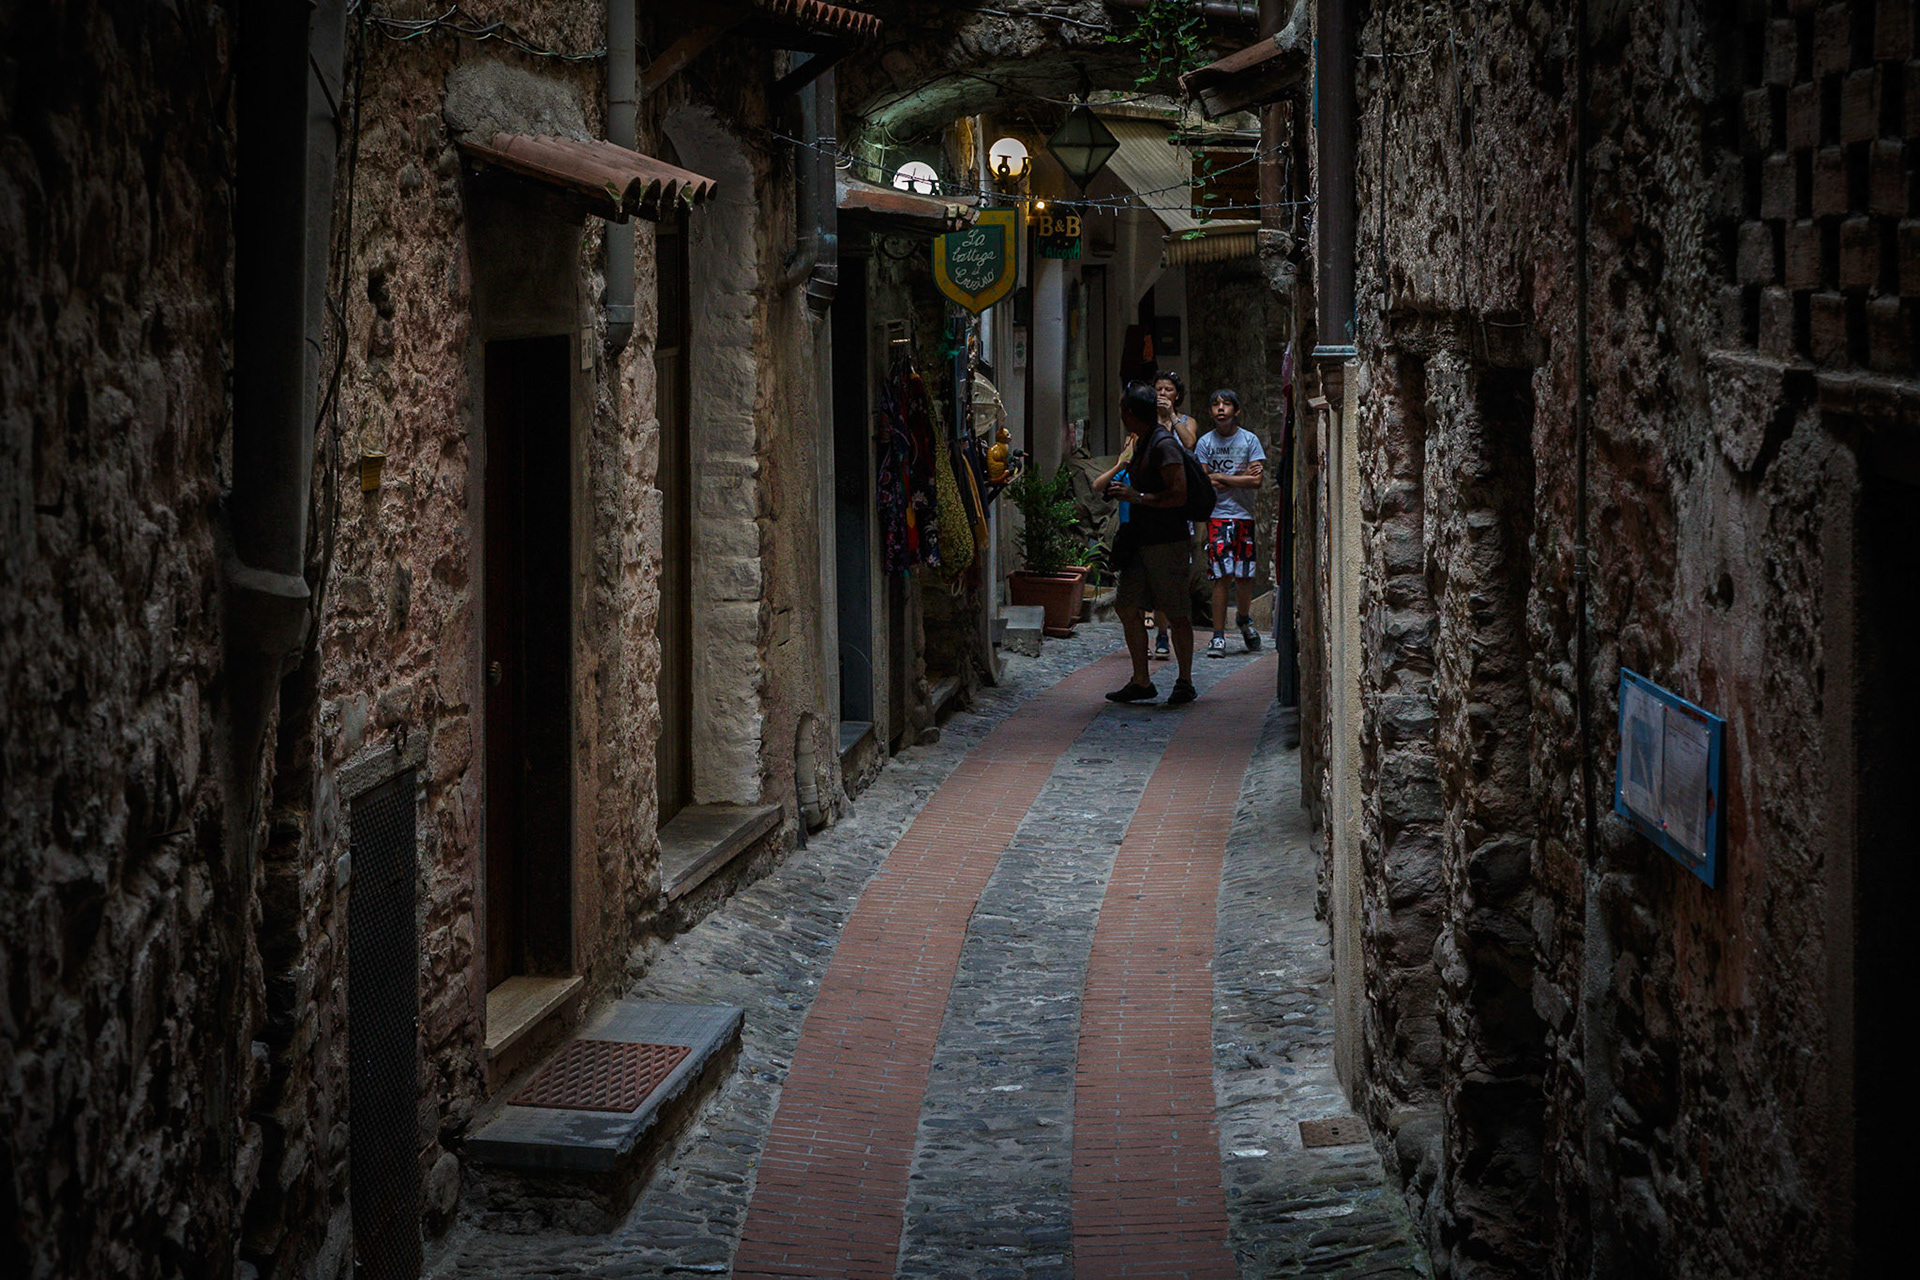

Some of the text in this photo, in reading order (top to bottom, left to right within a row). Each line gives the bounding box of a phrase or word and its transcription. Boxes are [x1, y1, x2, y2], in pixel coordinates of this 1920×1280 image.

[1038, 216, 1081, 237] B&B
[962, 229, 986, 247] La
[1207, 459, 1234, 470] NYC
